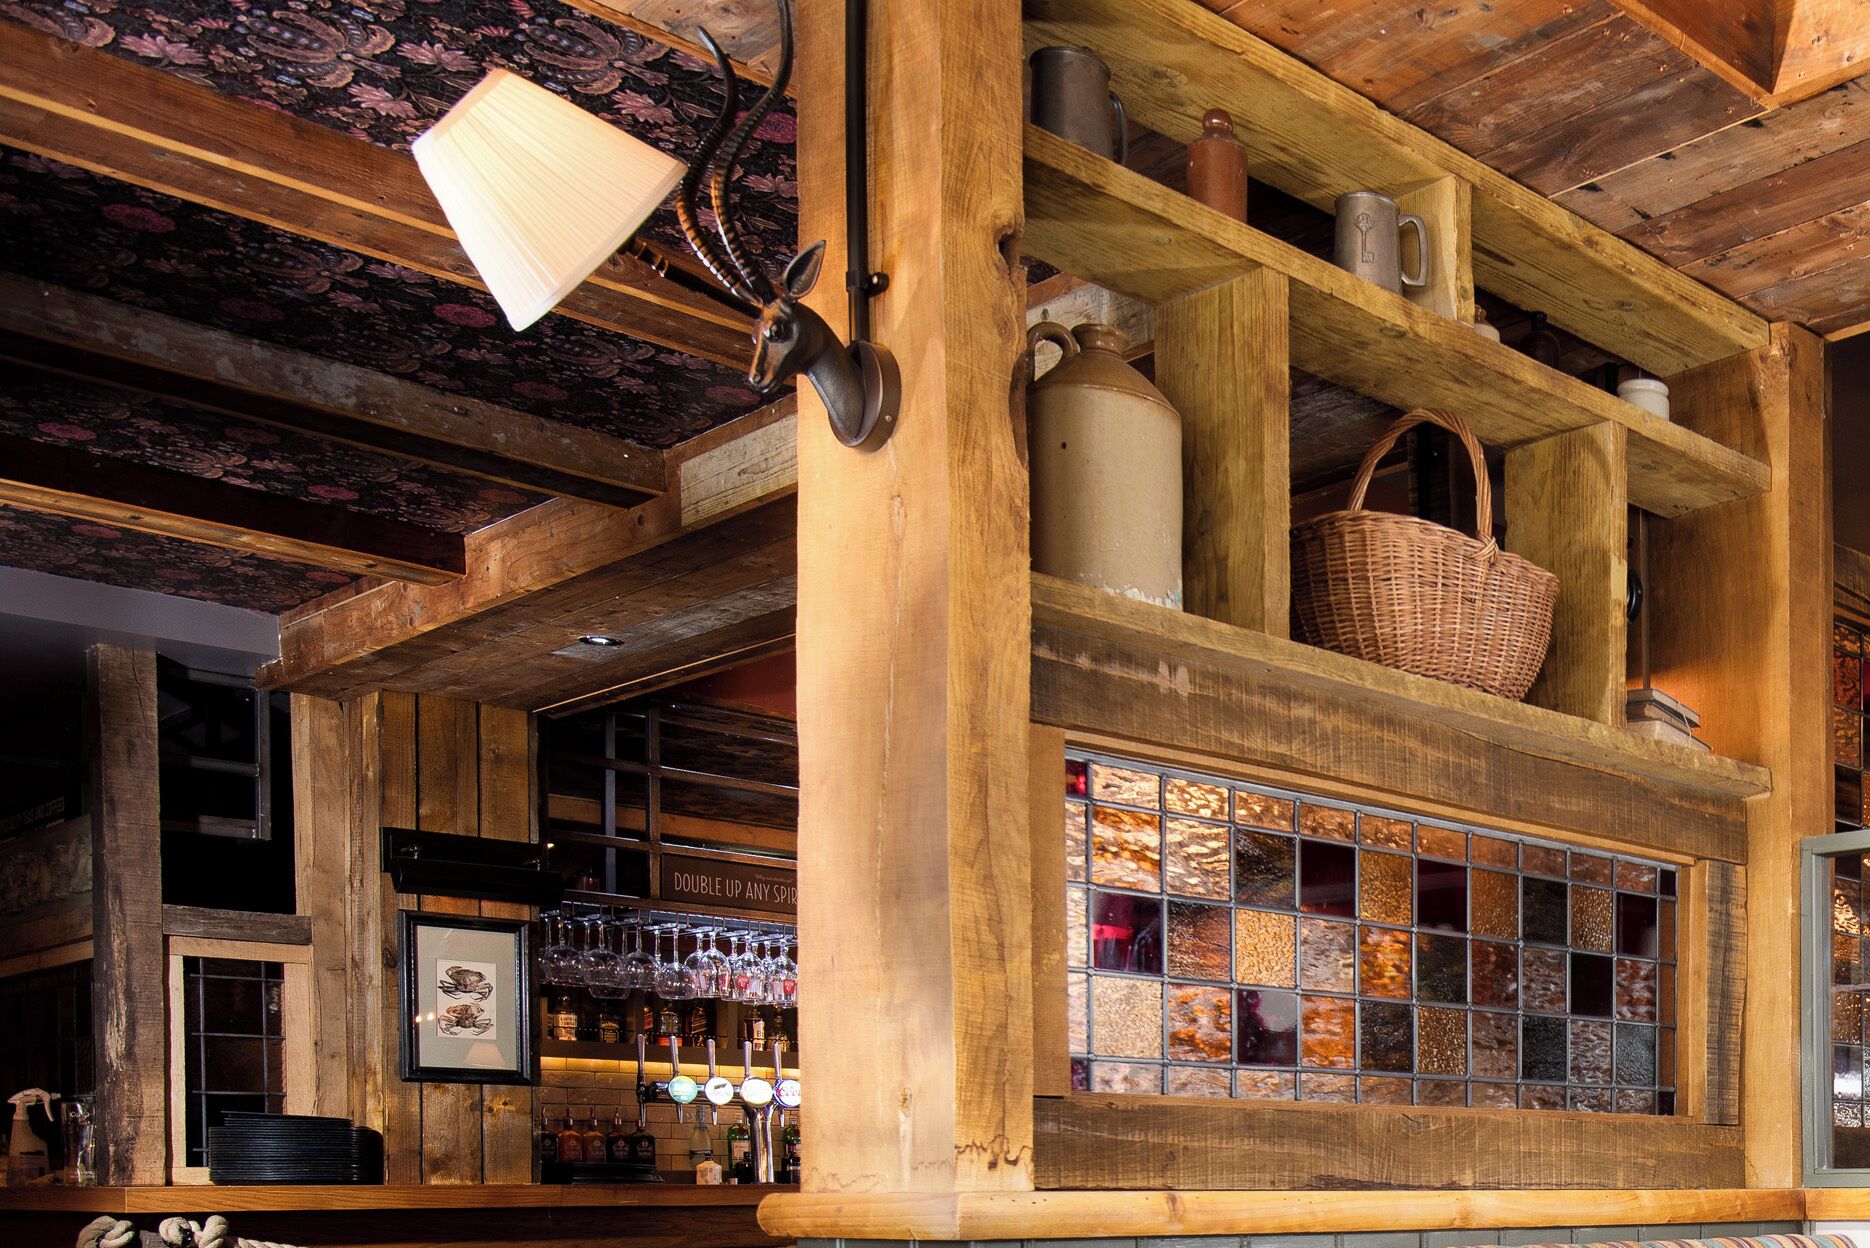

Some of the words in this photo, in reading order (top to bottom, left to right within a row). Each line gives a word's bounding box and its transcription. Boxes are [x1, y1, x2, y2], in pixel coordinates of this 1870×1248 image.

[674, 872, 723, 896] DOUBLE
[725, 879, 742, 898] UP
[745, 881, 771, 902] ANY
